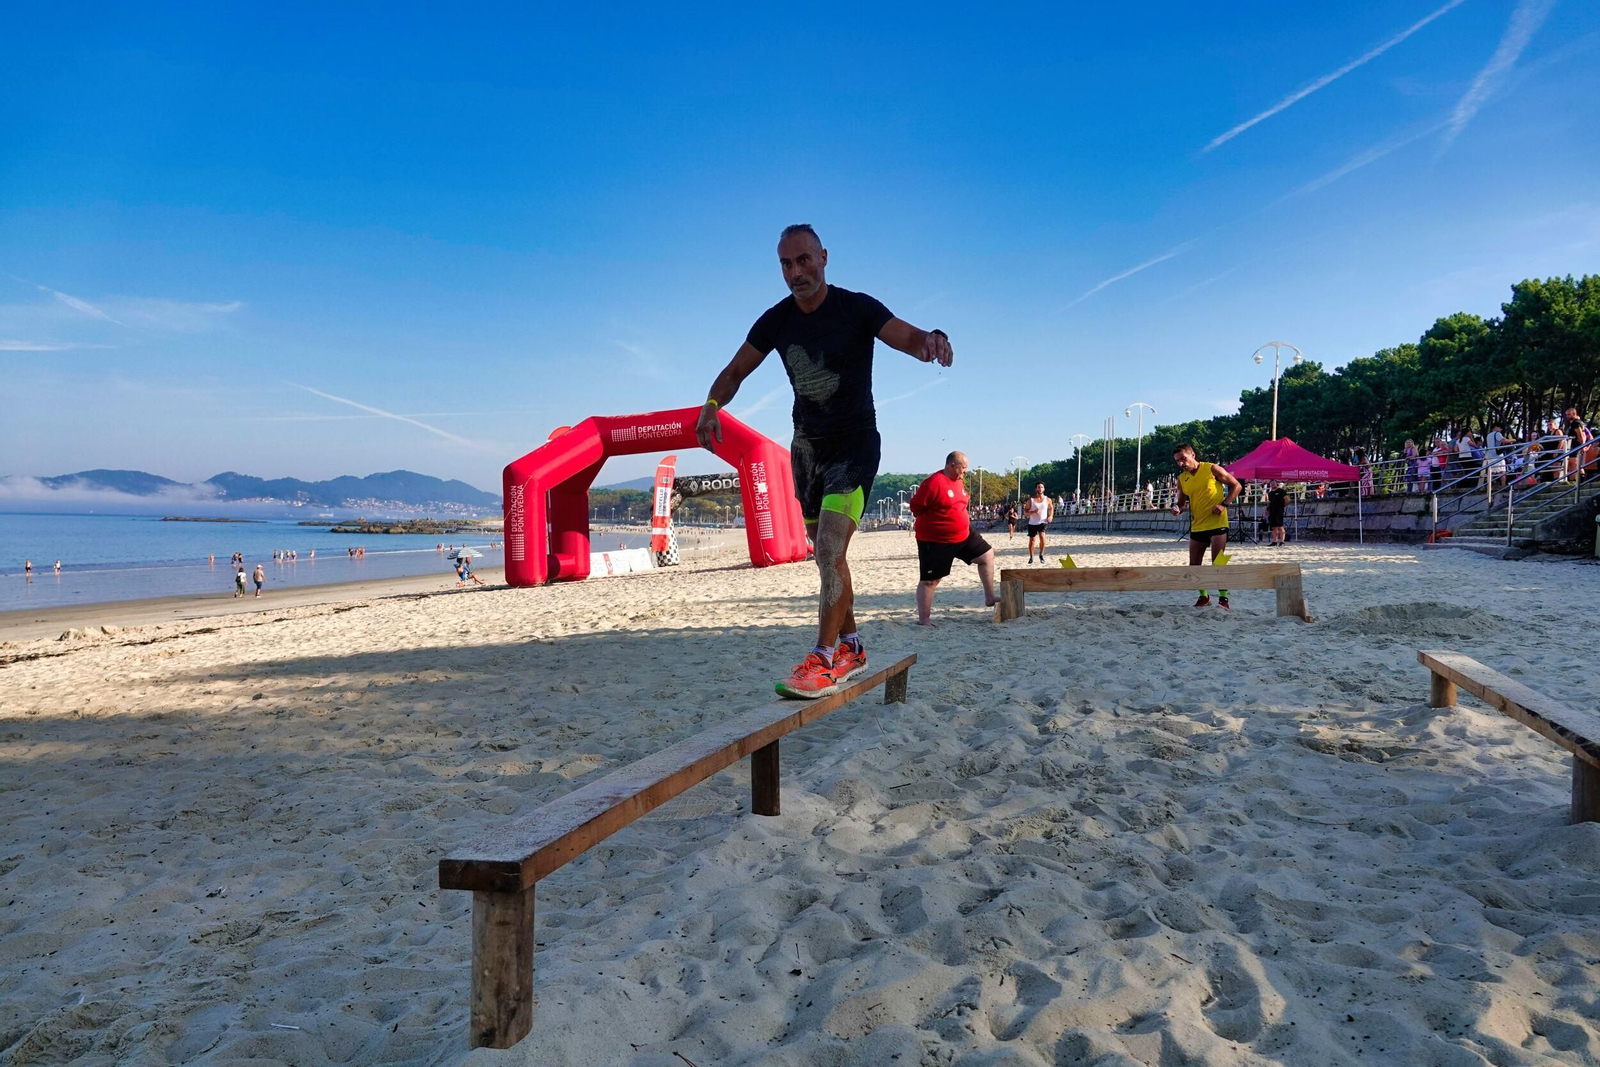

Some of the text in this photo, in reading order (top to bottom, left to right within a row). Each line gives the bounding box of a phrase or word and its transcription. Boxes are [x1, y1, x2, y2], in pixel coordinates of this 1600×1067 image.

[637, 421, 682, 433] DEPUTACIÓN
[638, 428, 683, 439] PONTEVEDRA
[516, 484, 525, 533] PONTEVEDRA
[750, 462, 764, 511] DEPUTACIÓN
[757, 461, 770, 510] PONEDRA
